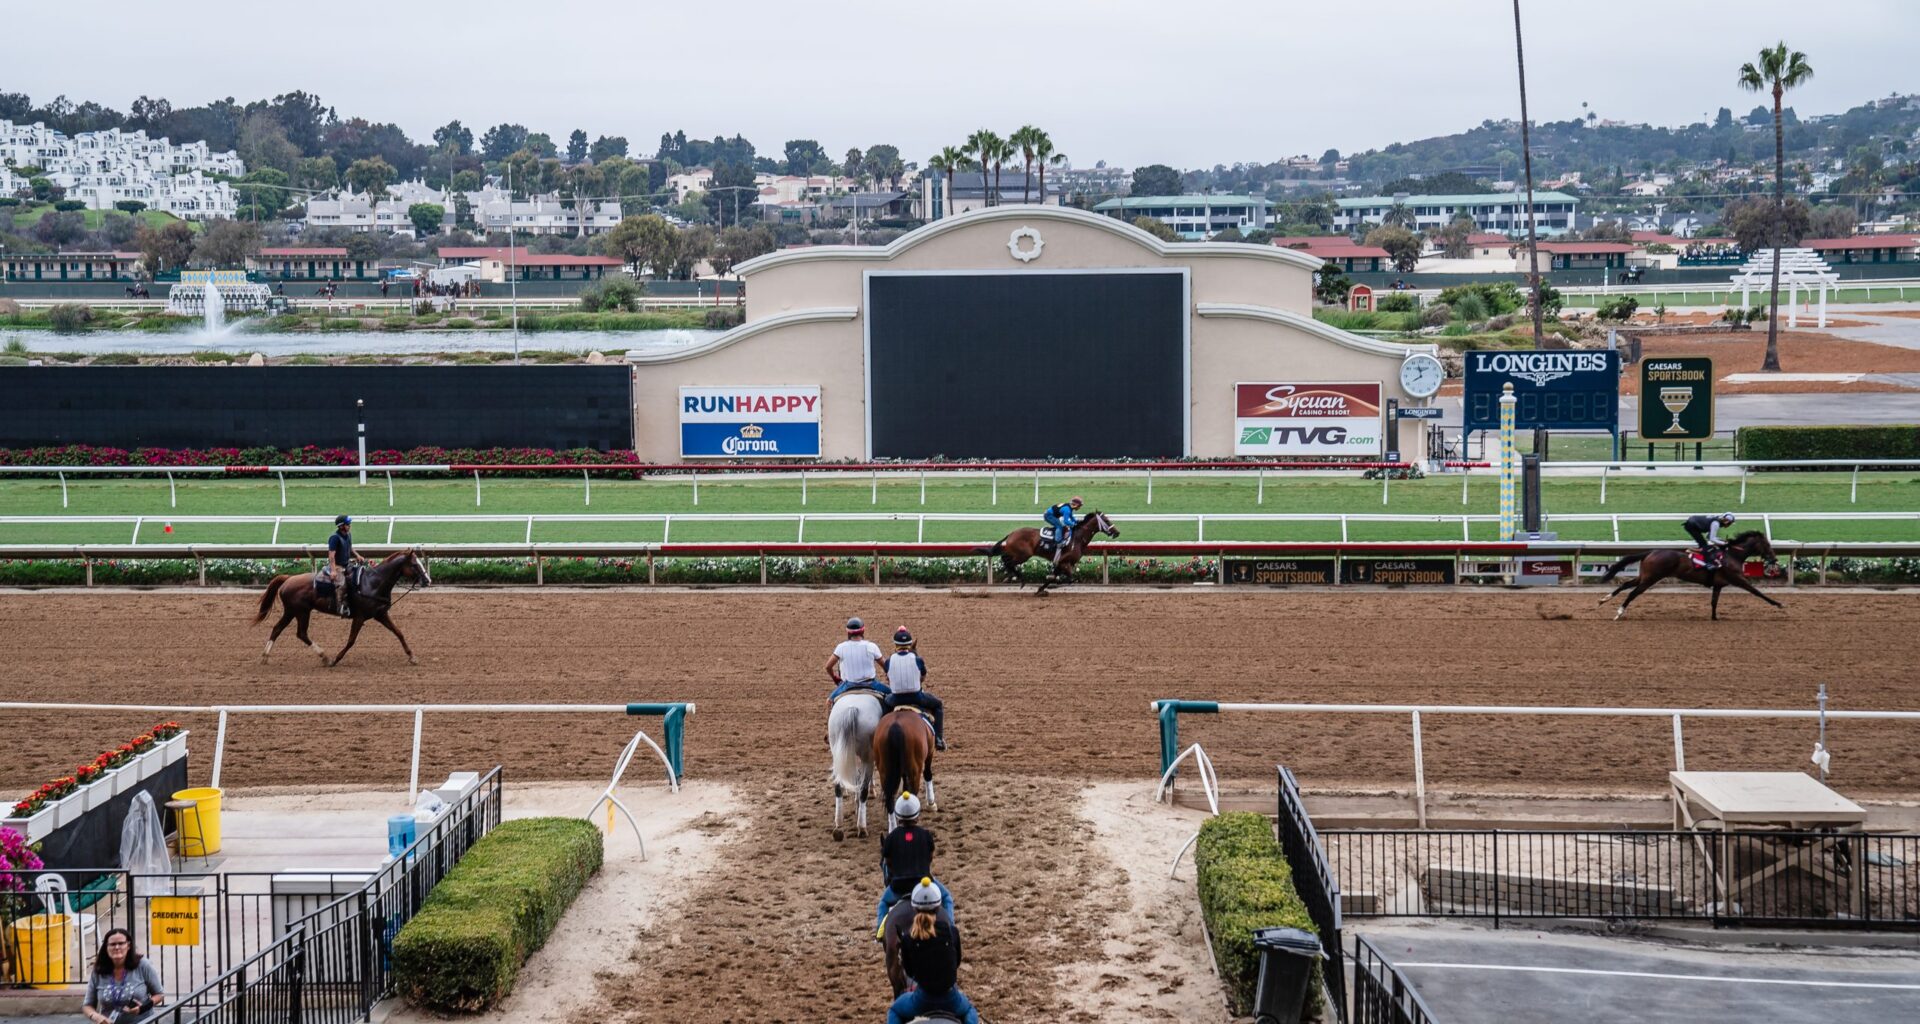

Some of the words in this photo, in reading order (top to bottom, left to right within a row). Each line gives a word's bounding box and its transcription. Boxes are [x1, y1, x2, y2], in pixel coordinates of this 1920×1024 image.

[1476, 353, 1607, 372] LONGINES
[1648, 370, 1705, 381] SPORTSBOOK
[684, 396, 817, 413] RUNHAPPY
[1264, 385, 1347, 417] Sycuan
[722, 436, 777, 455] Corona
[1256, 562, 1297, 570] CAESARS
[1374, 562, 1416, 570] CAESARS
[1256, 571, 1325, 583] SPORTSBOOK
[1374, 571, 1445, 583] SPORTSBOOK
